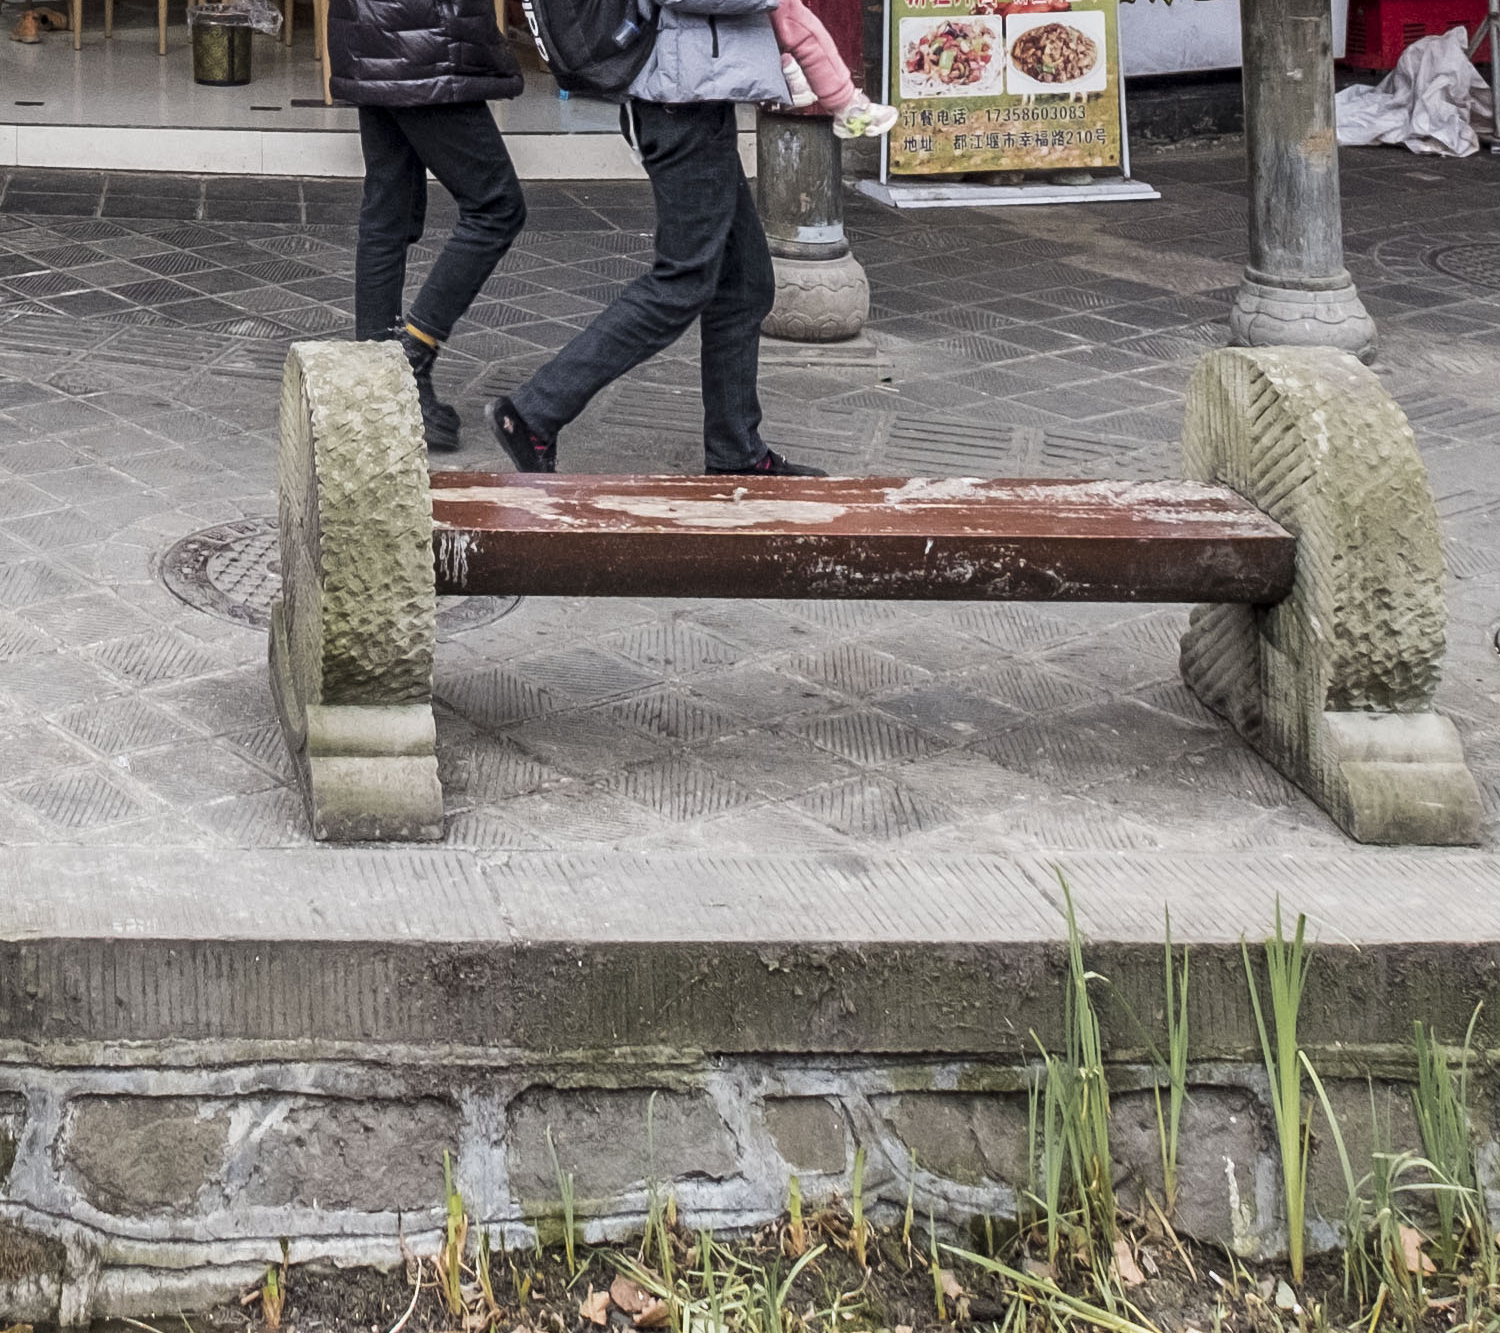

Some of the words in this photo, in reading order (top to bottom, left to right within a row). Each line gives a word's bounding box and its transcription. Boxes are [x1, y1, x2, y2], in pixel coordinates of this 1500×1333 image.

[985, 106, 1086, 123] 17358603083
[953, 129, 1107, 150] 都江堰市幸福路210号
